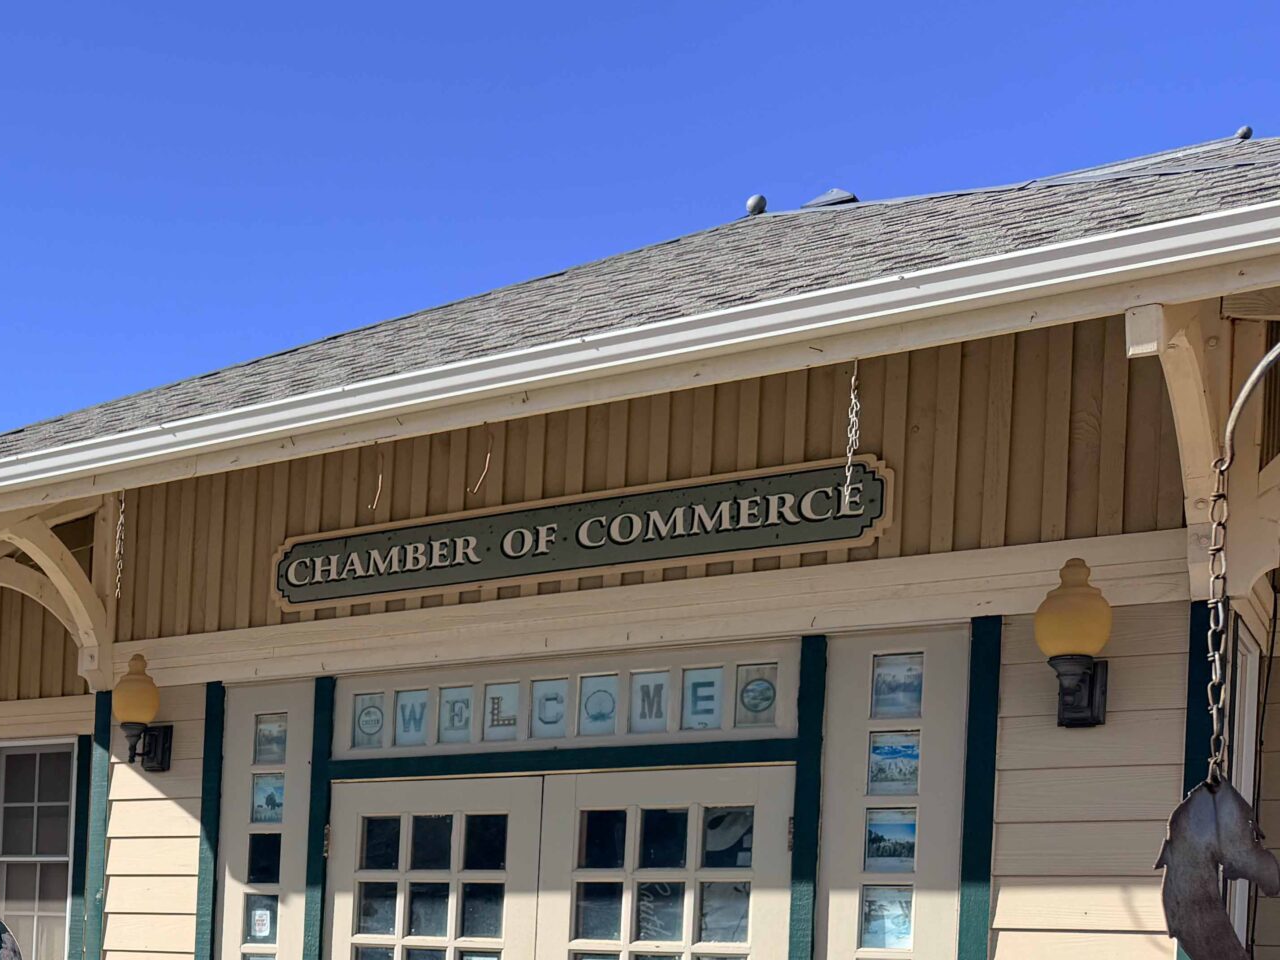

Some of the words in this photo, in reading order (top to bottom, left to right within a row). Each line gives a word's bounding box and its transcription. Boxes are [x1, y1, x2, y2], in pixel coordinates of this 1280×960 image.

[284, 535, 482, 588] CHAMBER
[501, 523, 559, 561] OF
[576, 482, 865, 549] COMMERCE
